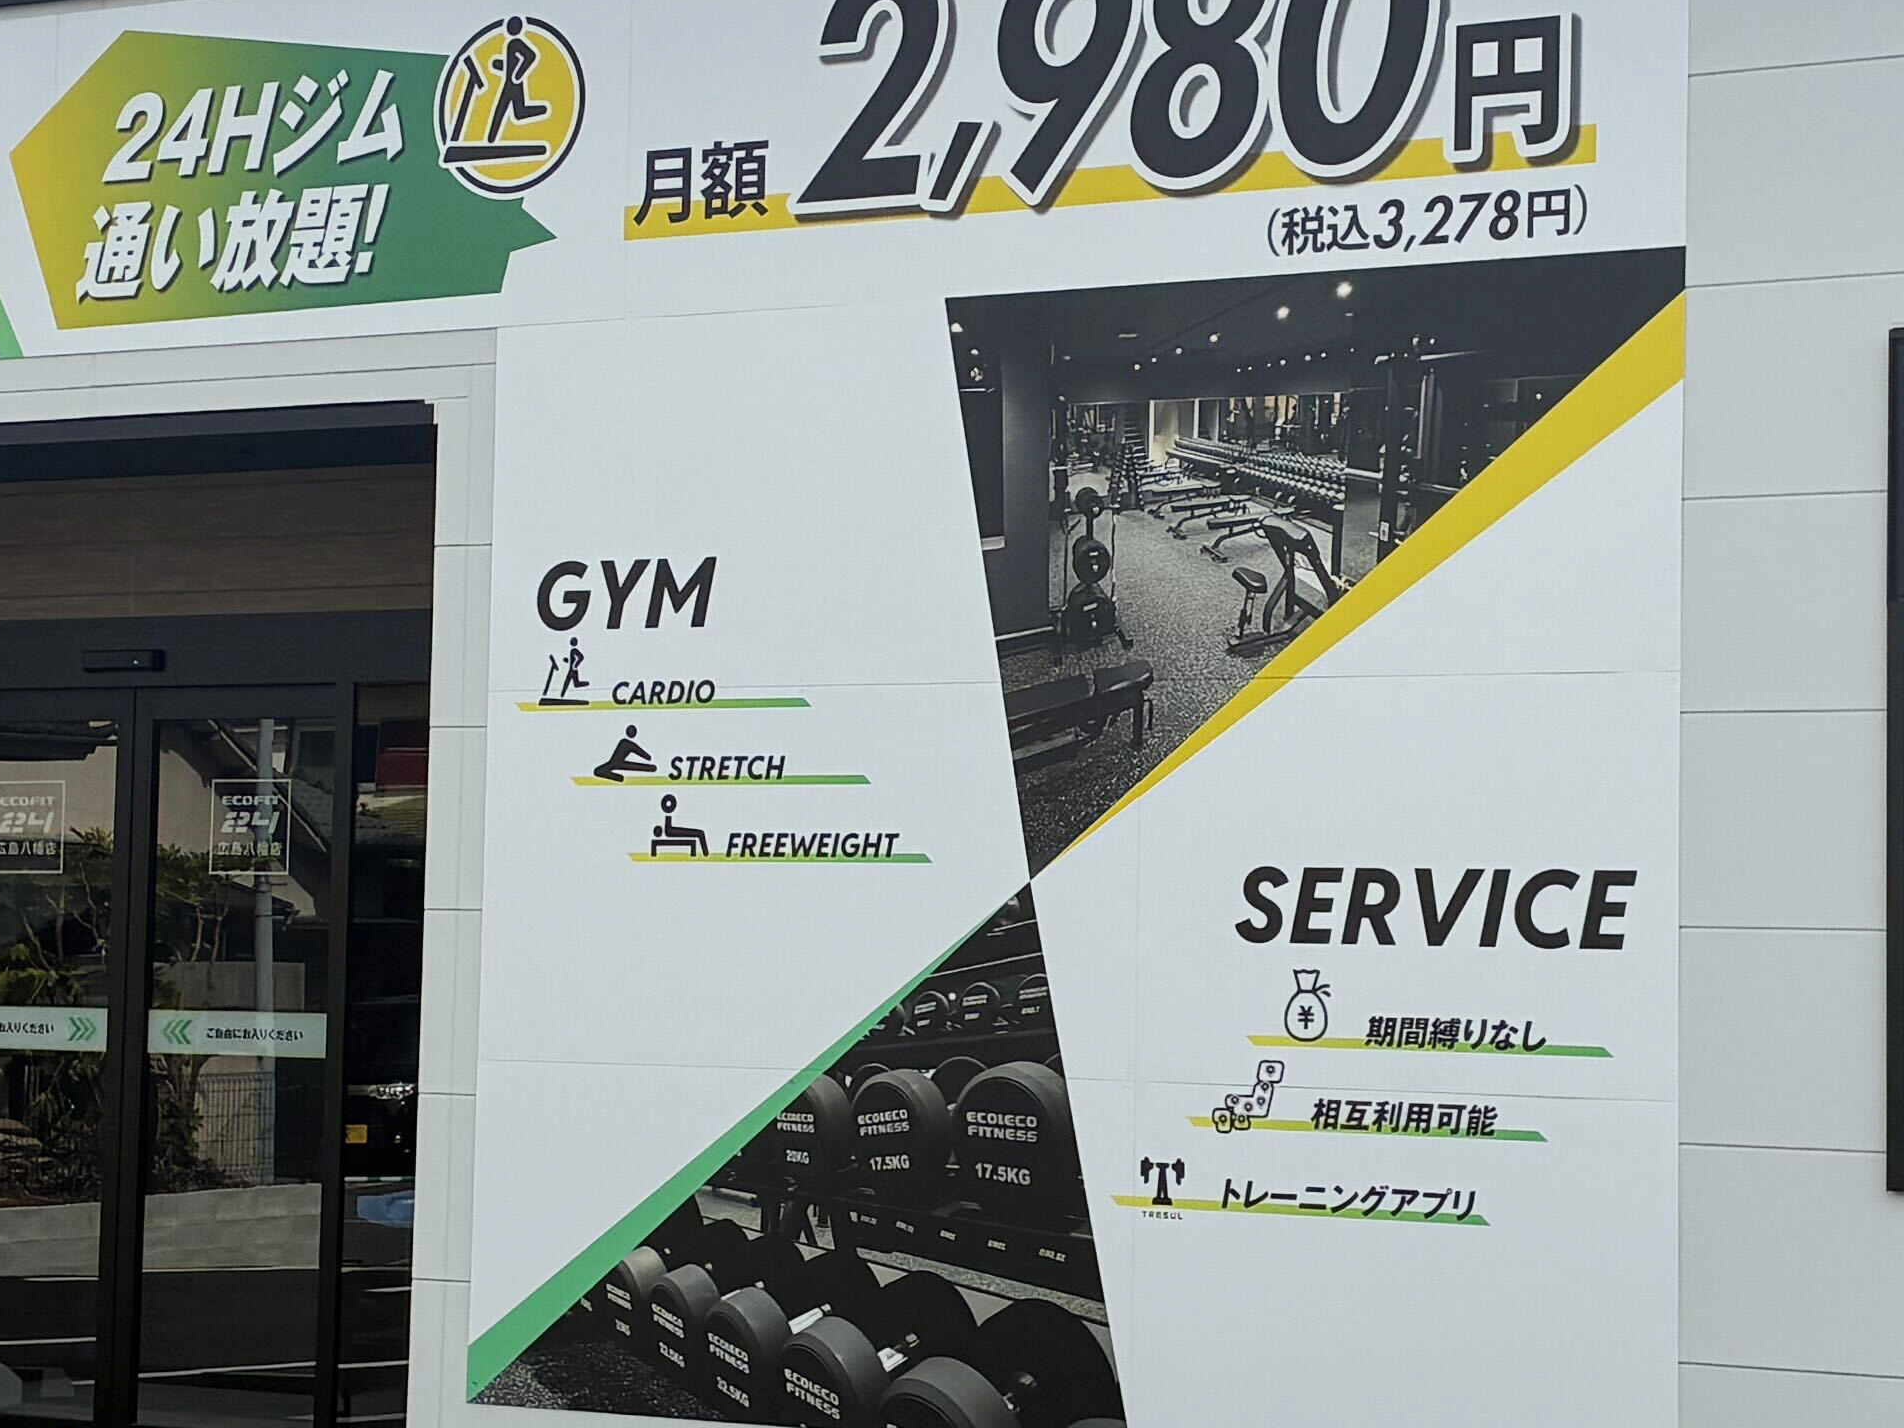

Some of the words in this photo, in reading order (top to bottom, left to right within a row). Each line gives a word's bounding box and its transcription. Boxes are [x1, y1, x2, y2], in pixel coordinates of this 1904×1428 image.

[101, 68, 403, 184] 24Hジム
[634, 140, 769, 226] 月額
[76, 183, 390, 303] 通い放題!
[536, 556, 717, 632] GYM
[612, 679, 715, 705] CARDIO
[668, 755, 786, 781] STRETCH
[0, 795, 56, 808] ECOFIT
[221, 795, 279, 807] ECOFIT
[0, 811, 55, 834] 24
[221, 811, 280, 834] 24
[725, 832, 900, 858] FREEWEIGHT
[1234, 866, 1638, 950] SERVICE
[1364, 1016, 1547, 1052] 期間縛りなし
[860, 1121, 910, 1136] FITNESS
[1310, 1098, 1498, 1137] 相互利用可能
[967, 1125, 1038, 1142] FITNESS
[869, 1154, 910, 1170] 17.5KG
[975, 1162, 1031, 1185] 17.5KG
[1221, 1178, 1476, 1222] トレーニングアプリ
[786, 1381, 841, 1420] FITNESS
